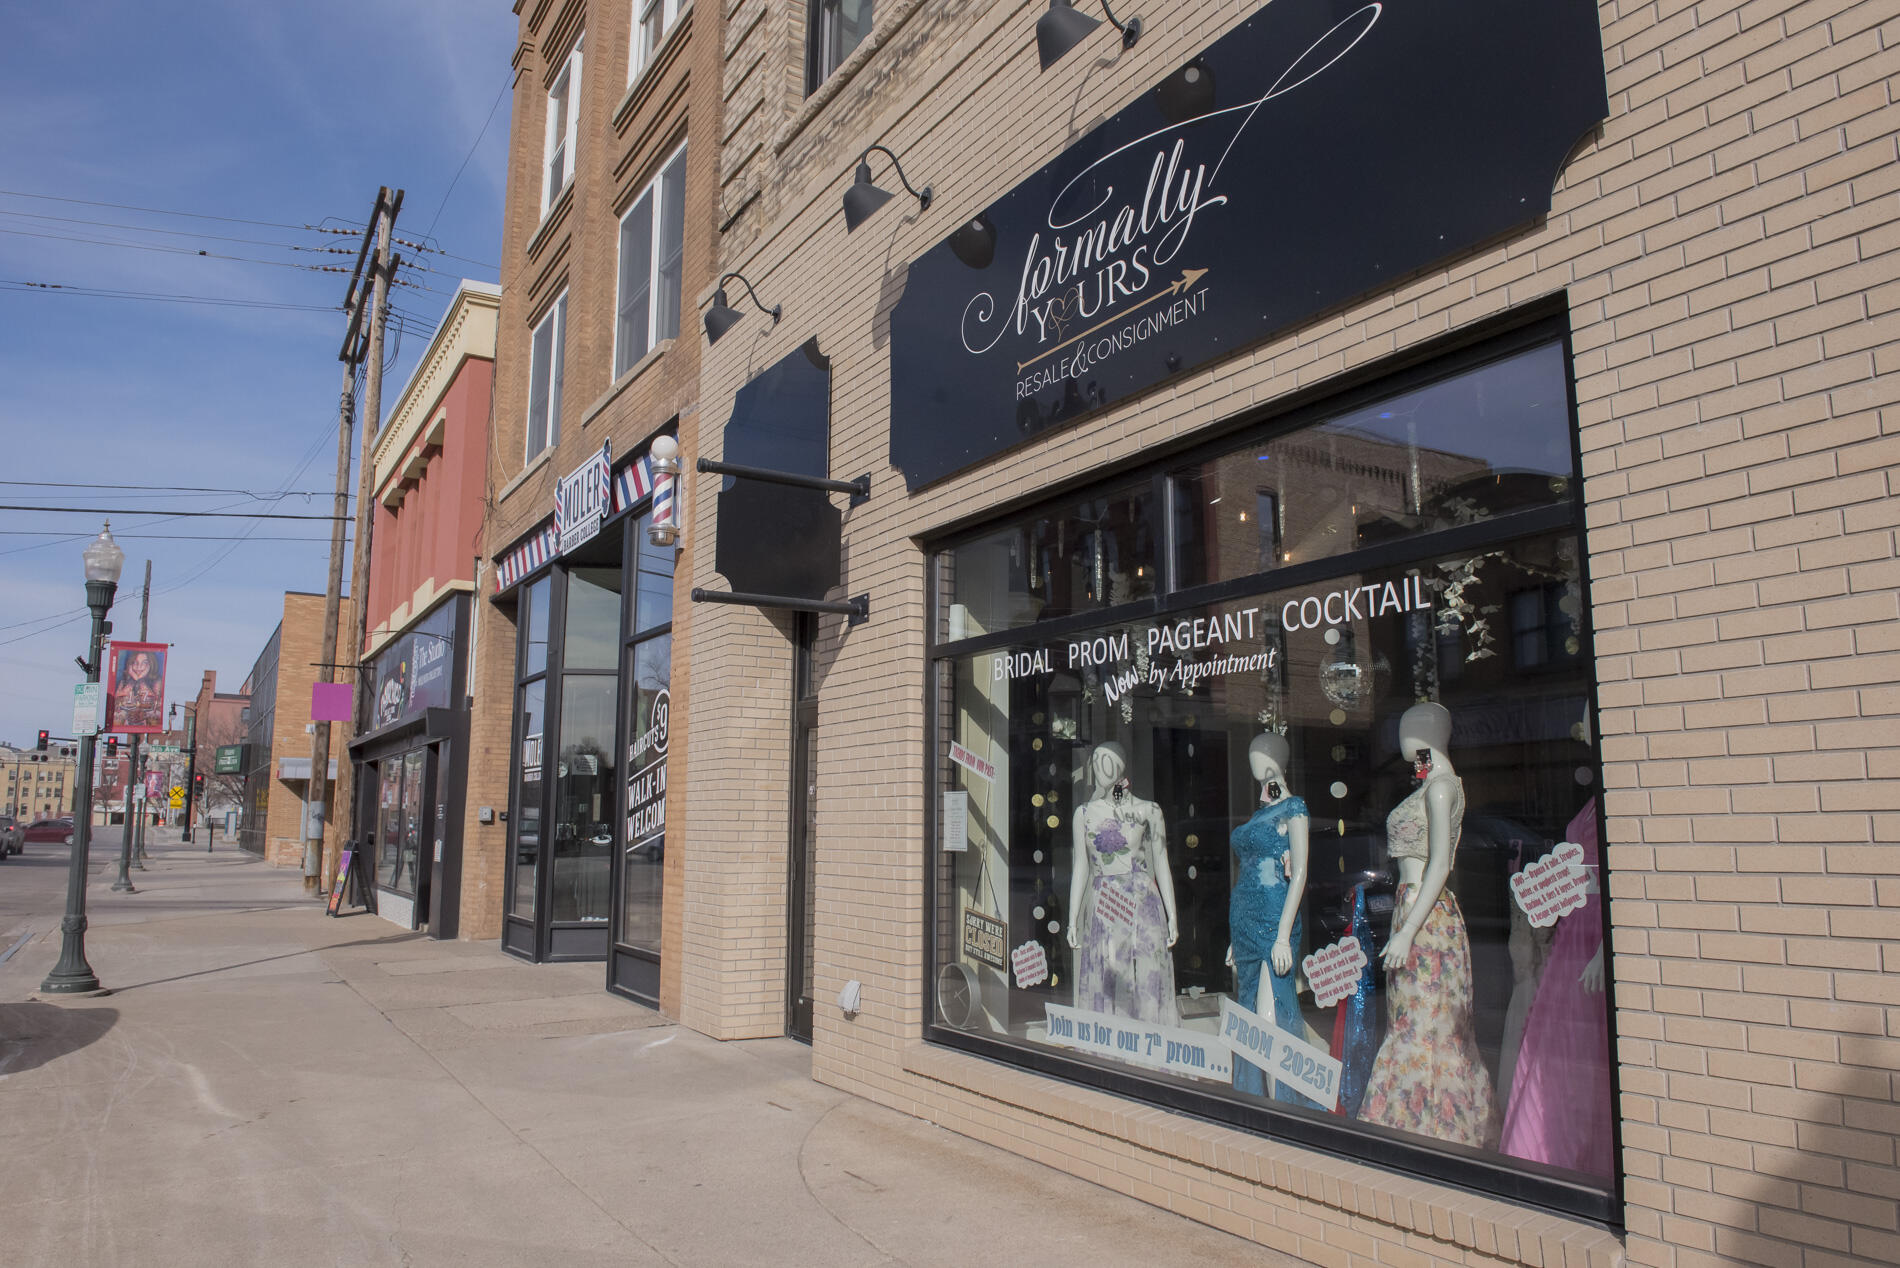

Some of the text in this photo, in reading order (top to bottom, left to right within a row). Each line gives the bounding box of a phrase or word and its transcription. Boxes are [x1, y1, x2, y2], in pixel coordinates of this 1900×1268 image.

[1088, 288, 1209, 362] CONSIGNMENT
[563, 461, 600, 531] MOLER
[563, 518, 600, 551] BARBER COLLEGE
[994, 575, 1431, 681] BRIDAL PROM PAGEANT COCKTAIL
[419, 638, 445, 669] The Studio
[1103, 648, 1277, 707] Now by Appointment
[629, 725, 659, 762] HAIRCUTS
[965, 925, 1003, 957] CLOSED
[966, 913, 984, 931] SORRY
[1050, 1012, 1073, 1039] Join
[1077, 1024, 1091, 1043] us
[1094, 1019, 1112, 1046] for
[1117, 1029, 1139, 1051] our
[1144, 1032, 1162, 1057] 7th
[1225, 1014, 1335, 1095] PROM 2025!
